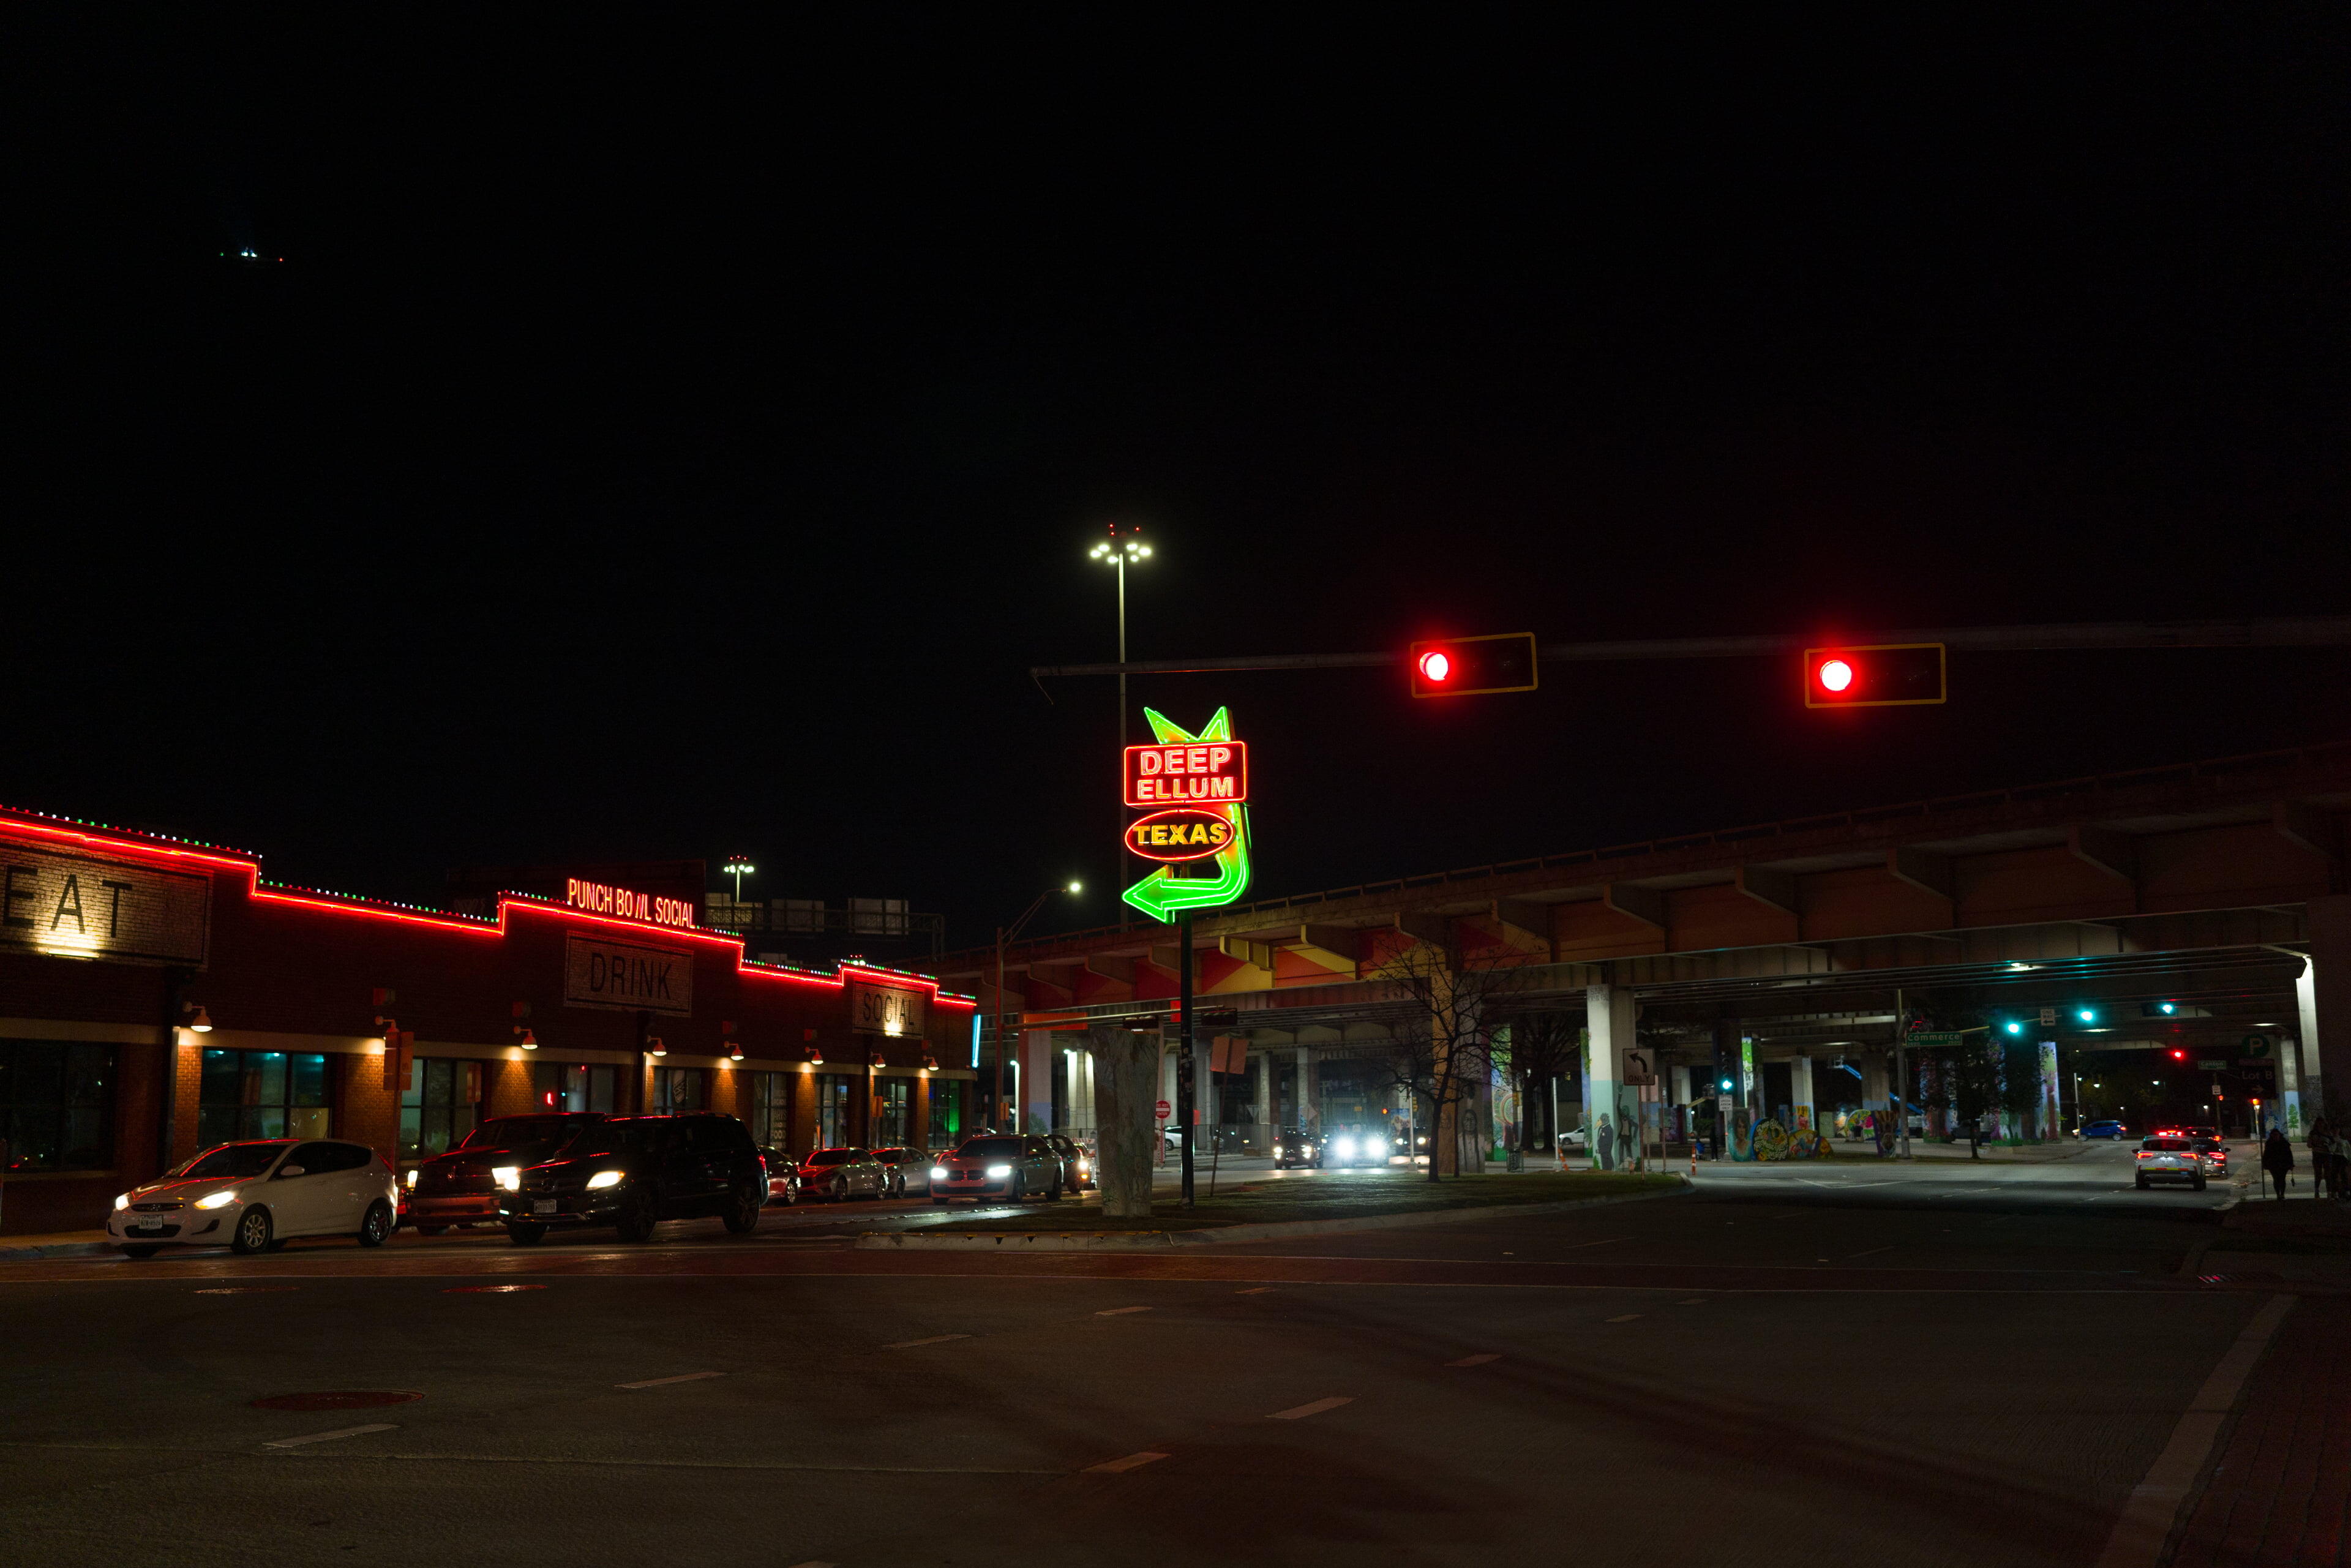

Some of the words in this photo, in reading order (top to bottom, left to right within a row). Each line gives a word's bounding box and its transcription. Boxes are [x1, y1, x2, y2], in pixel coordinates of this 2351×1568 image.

[1140, 747, 1231, 776] DEEP
[1137, 776, 1234, 800] ELLUM
[1133, 822, 1228, 846] TEXAS
[4, 865, 132, 938] EAT
[568, 877, 613, 913] PUNCH
[656, 896, 696, 929] SOCIAL
[590, 951, 672, 1000] DRINK
[863, 992, 914, 1026] SOCIAL
[2249, 1038, 2263, 1054] P
[2242, 1070, 2260, 1080] Lot
[2265, 1070, 2274, 1080] B
